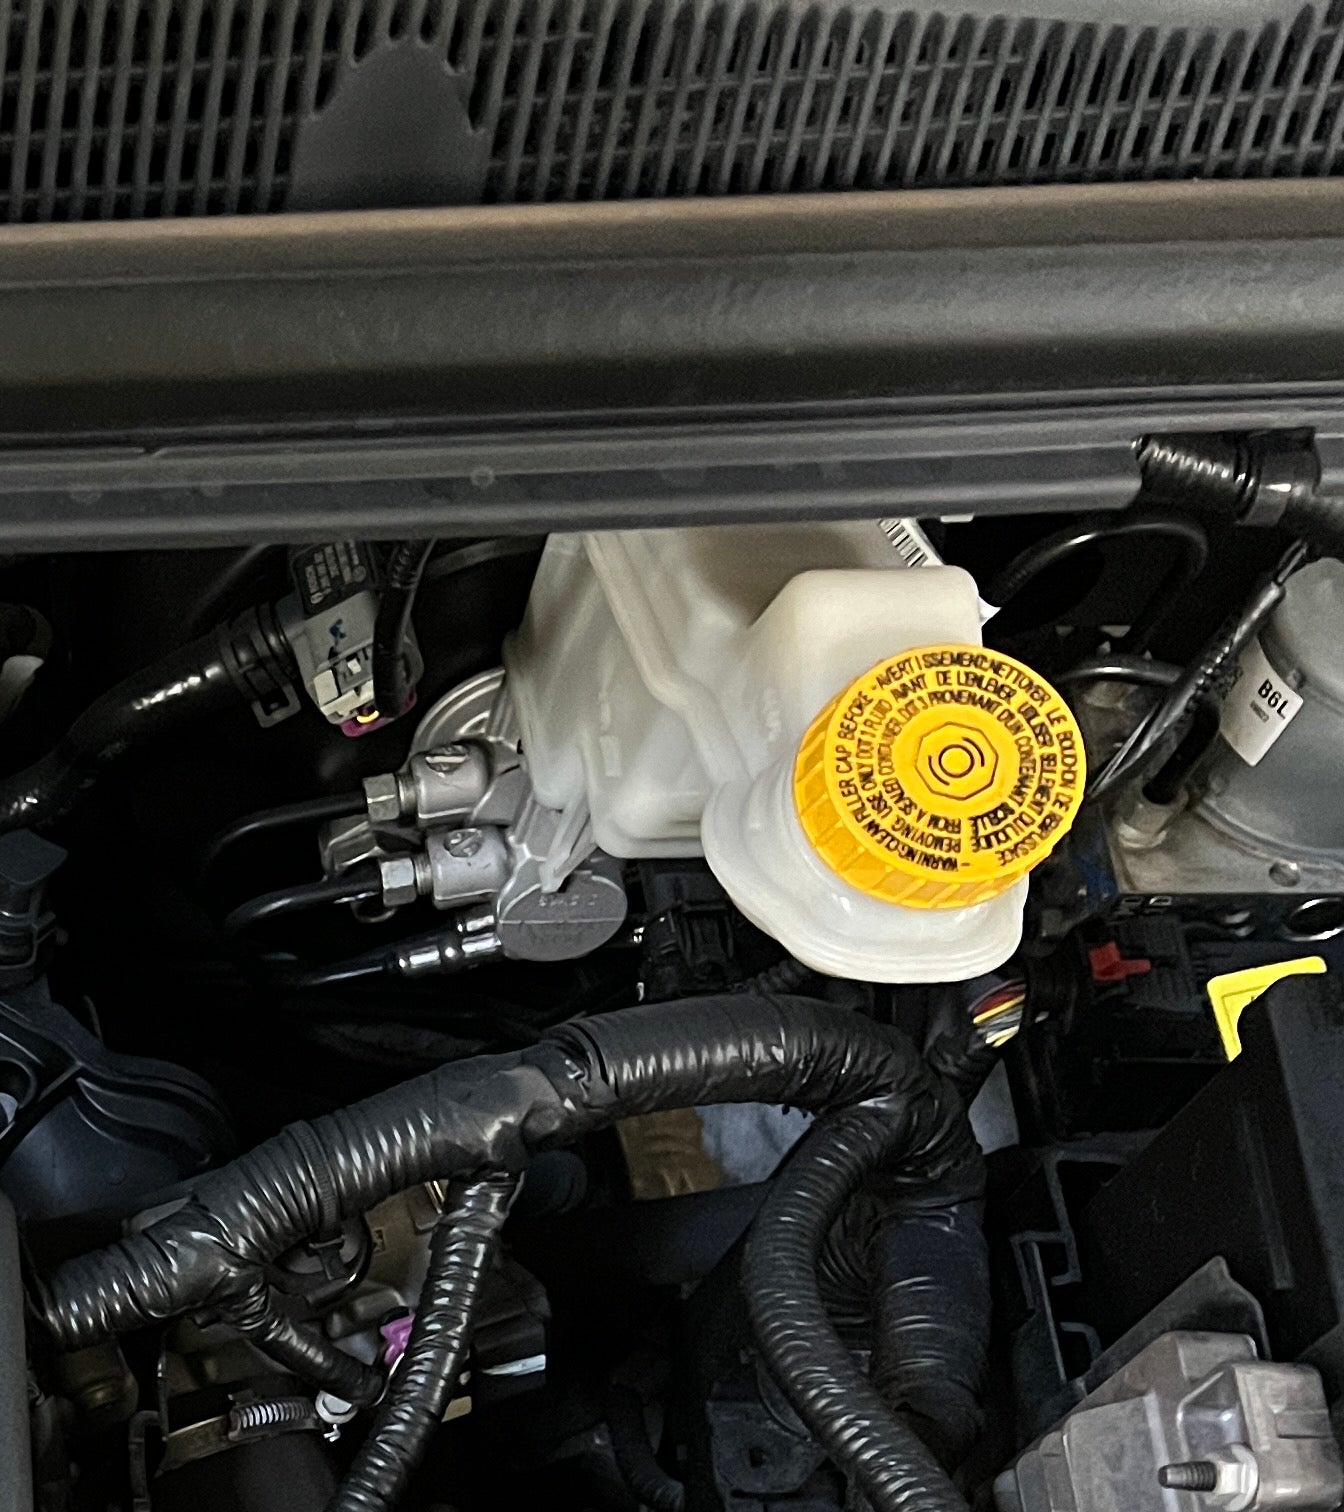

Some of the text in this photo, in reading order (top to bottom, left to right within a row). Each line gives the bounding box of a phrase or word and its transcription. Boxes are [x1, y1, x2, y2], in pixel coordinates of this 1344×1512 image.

[936, 670, 951, 685] DE
[1257, 678, 1288, 720] B6L
[836, 690, 873, 739] BEFORE
[1046, 706, 1067, 726] LE
[835, 745, 851, 773] CAP
[1056, 731, 1077, 789] BOUCHON
[856, 762, 876, 790] ONLY
[838, 777, 870, 823] FILLER
[865, 790, 892, 819] USE
[917, 808, 925, 819] A
[1052, 792, 1073, 812] DE
[927, 814, 960, 833] FROM
